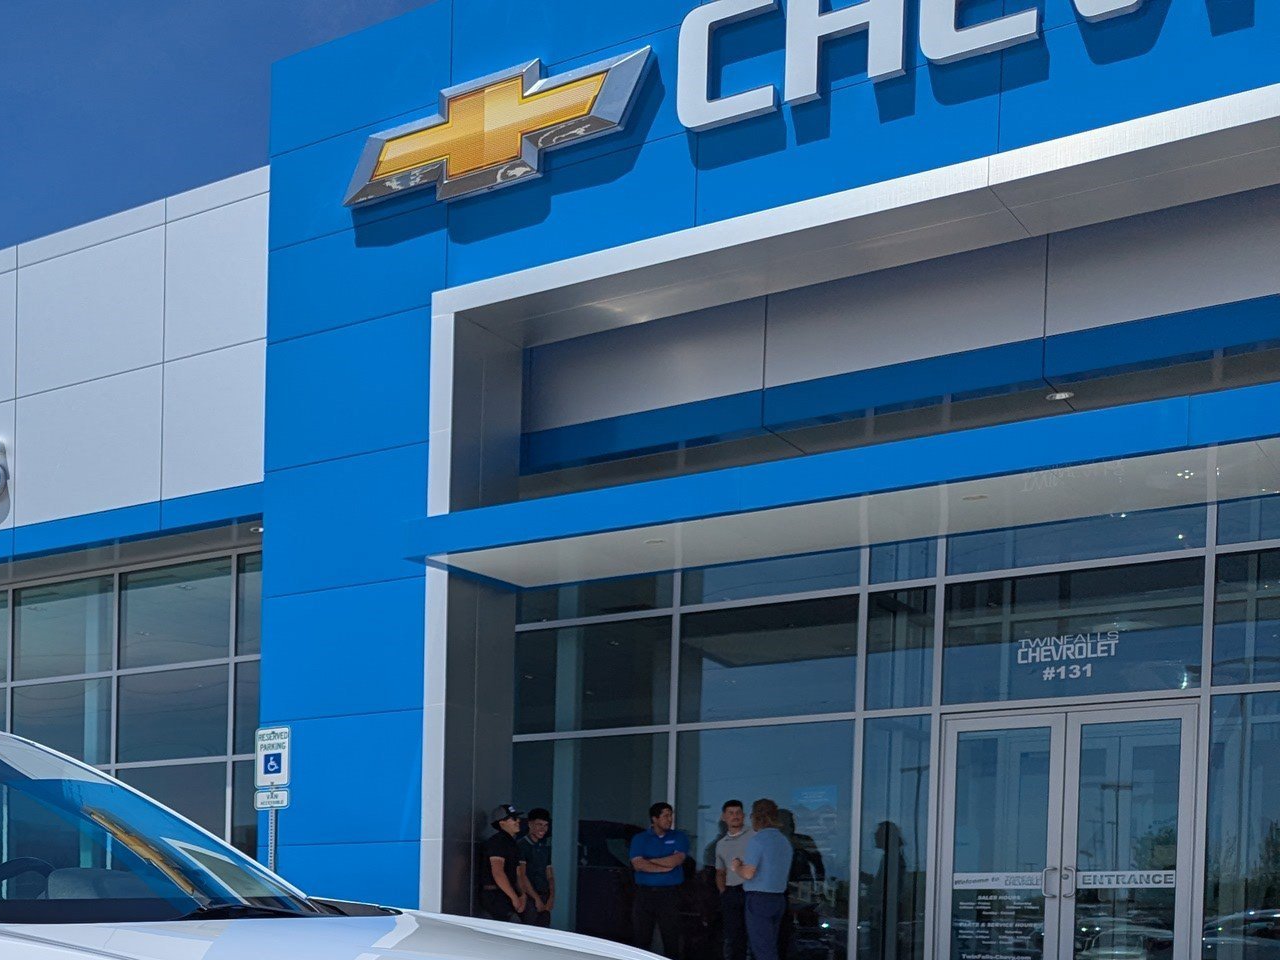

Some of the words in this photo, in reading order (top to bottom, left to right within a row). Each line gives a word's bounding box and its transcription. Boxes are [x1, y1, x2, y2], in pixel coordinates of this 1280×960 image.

[677, 0, 1142, 131] CH
[1017, 640, 1119, 664] CHEVROLET
[1042, 663, 1093, 681] #131
[259, 732, 289, 742] RESERVED
[260, 742, 286, 752] PARKING
[1082, 874, 1174, 885] ENTRANCE
